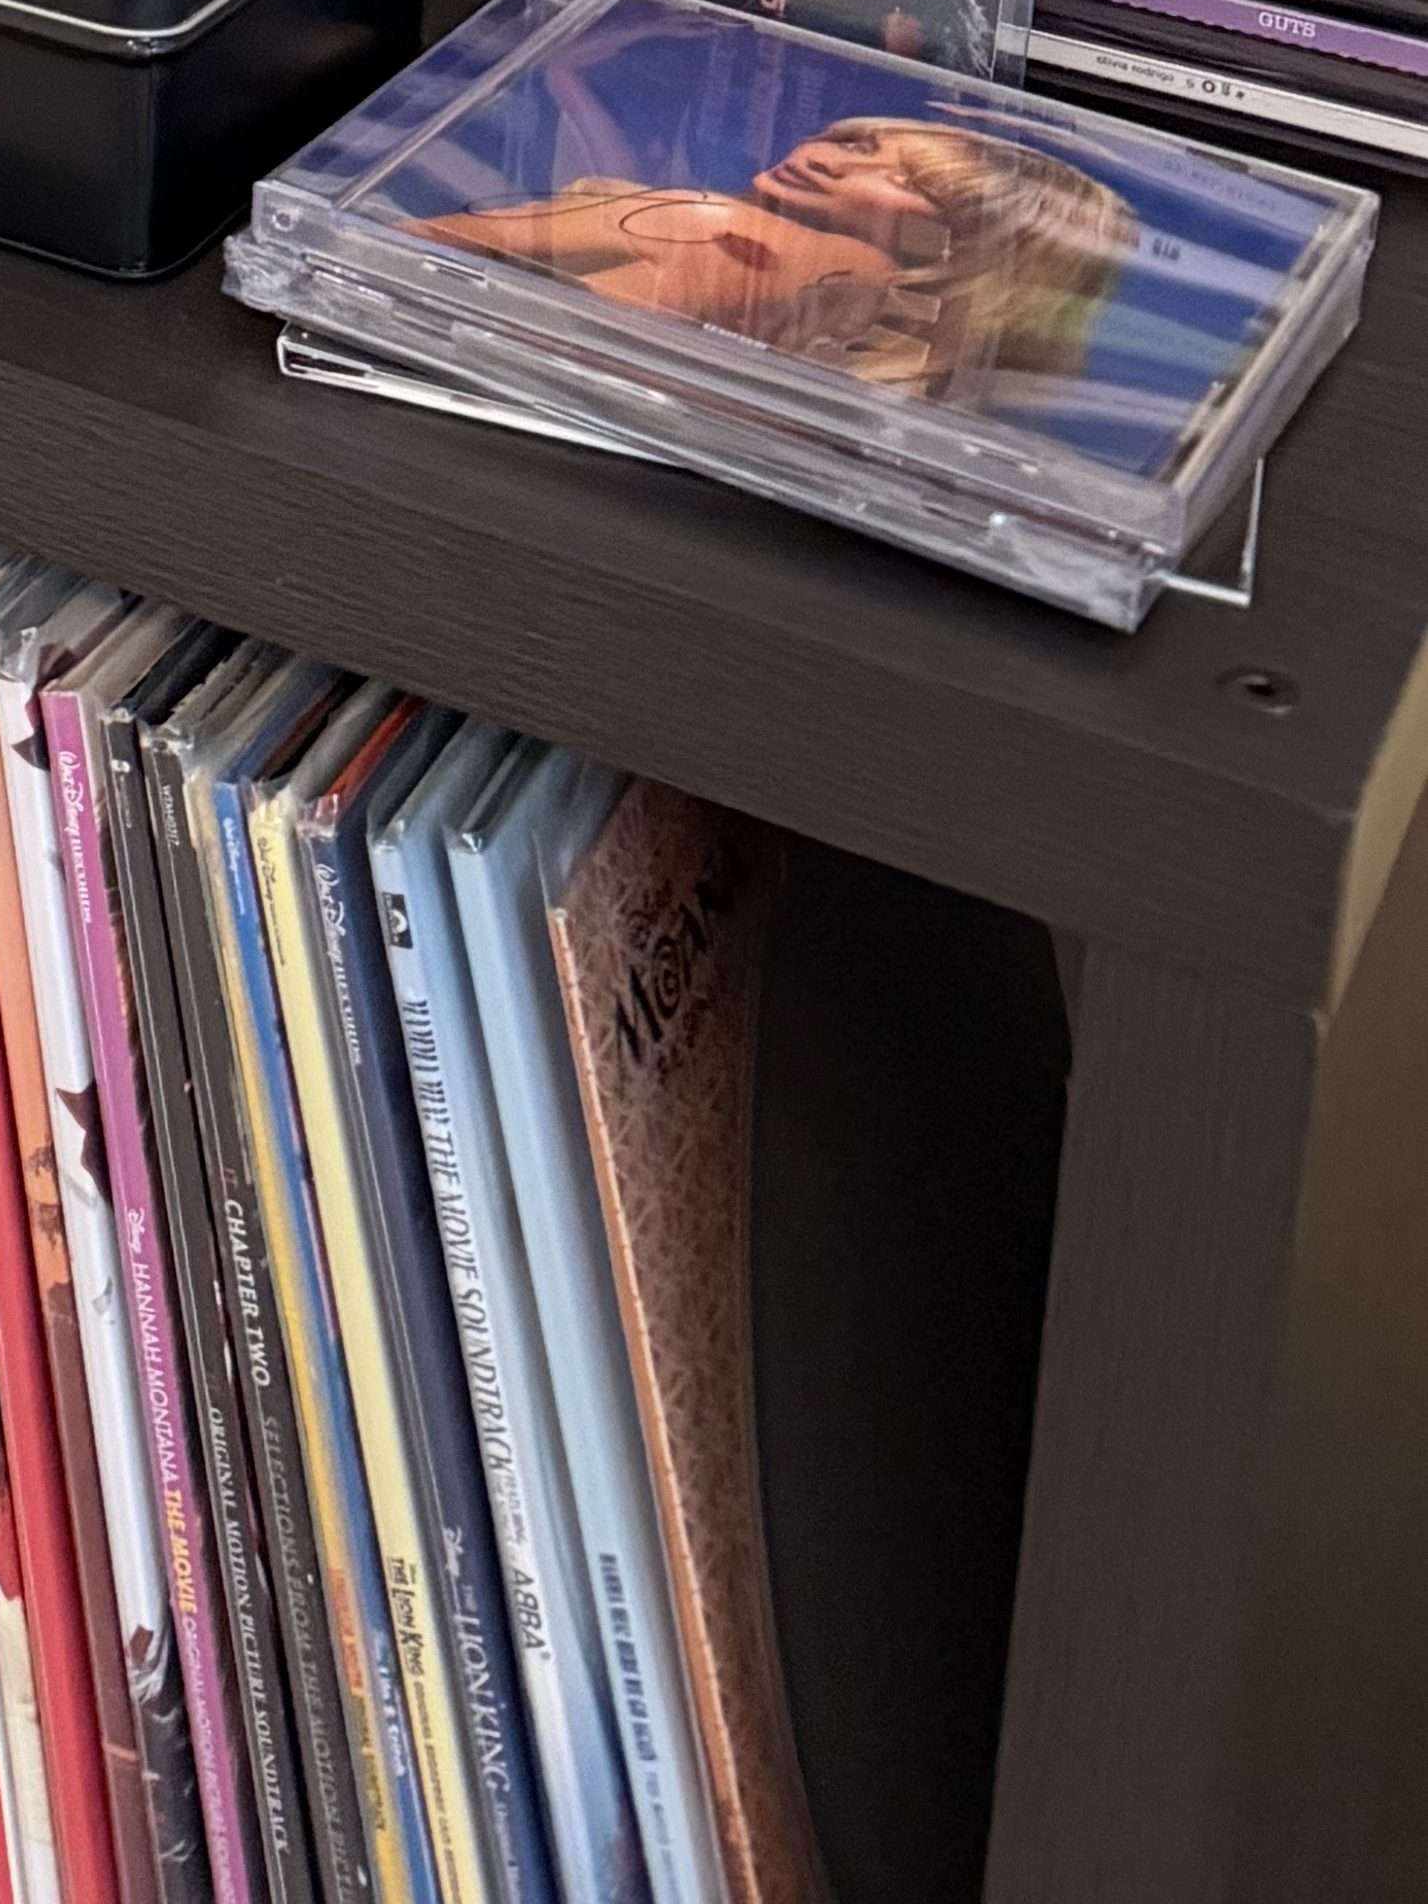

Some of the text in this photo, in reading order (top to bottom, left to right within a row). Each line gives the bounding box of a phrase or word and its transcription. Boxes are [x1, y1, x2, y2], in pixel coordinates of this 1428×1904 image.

[1258, 10, 1315, 38] GUTS
[122, 1206, 197, 1613] Disney HANNAH MONTANA THE MOVIE
[426, 1130, 514, 1473] THE MOVIE SOUNDTRACK
[208, 1406, 290, 1855] ORIGINAL MOTION PICTURE SOUNDTRACK
[224, 1199, 342, 1824] CHAPTER TWO SELECTIONS FROM THE MOTION
[391, 1588, 429, 1676] LION KING
[509, 1567, 547, 1650] ABBA
[453, 1612, 512, 1792] LION KING
